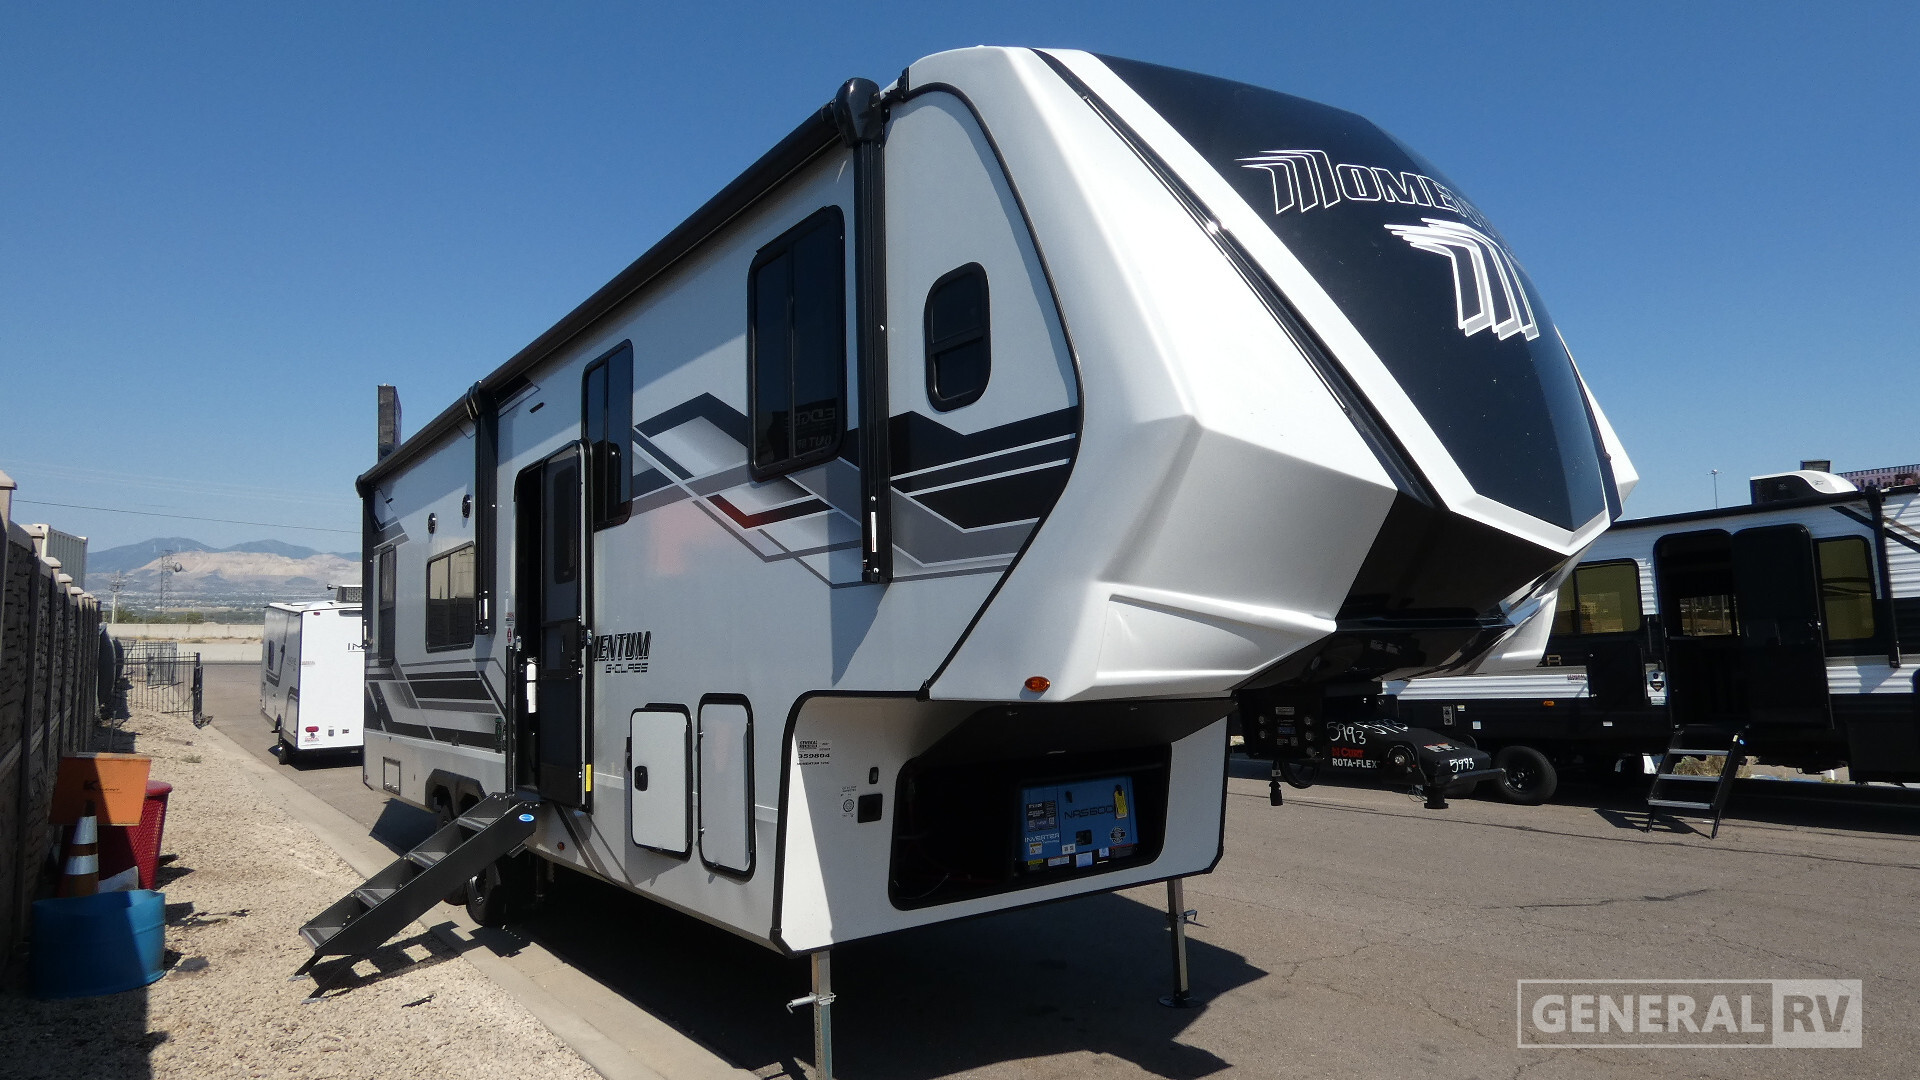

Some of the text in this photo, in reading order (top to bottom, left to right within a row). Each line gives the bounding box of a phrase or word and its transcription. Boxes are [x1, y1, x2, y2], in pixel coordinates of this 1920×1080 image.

[605, 663, 649, 673] G-CLASS
[1326, 721, 1366, 745] 5993
[1332, 758, 1377, 768] ROTA-FLEX
[1449, 757, 1475, 773] 5993
[1024, 832, 1060, 843] INVERTER
